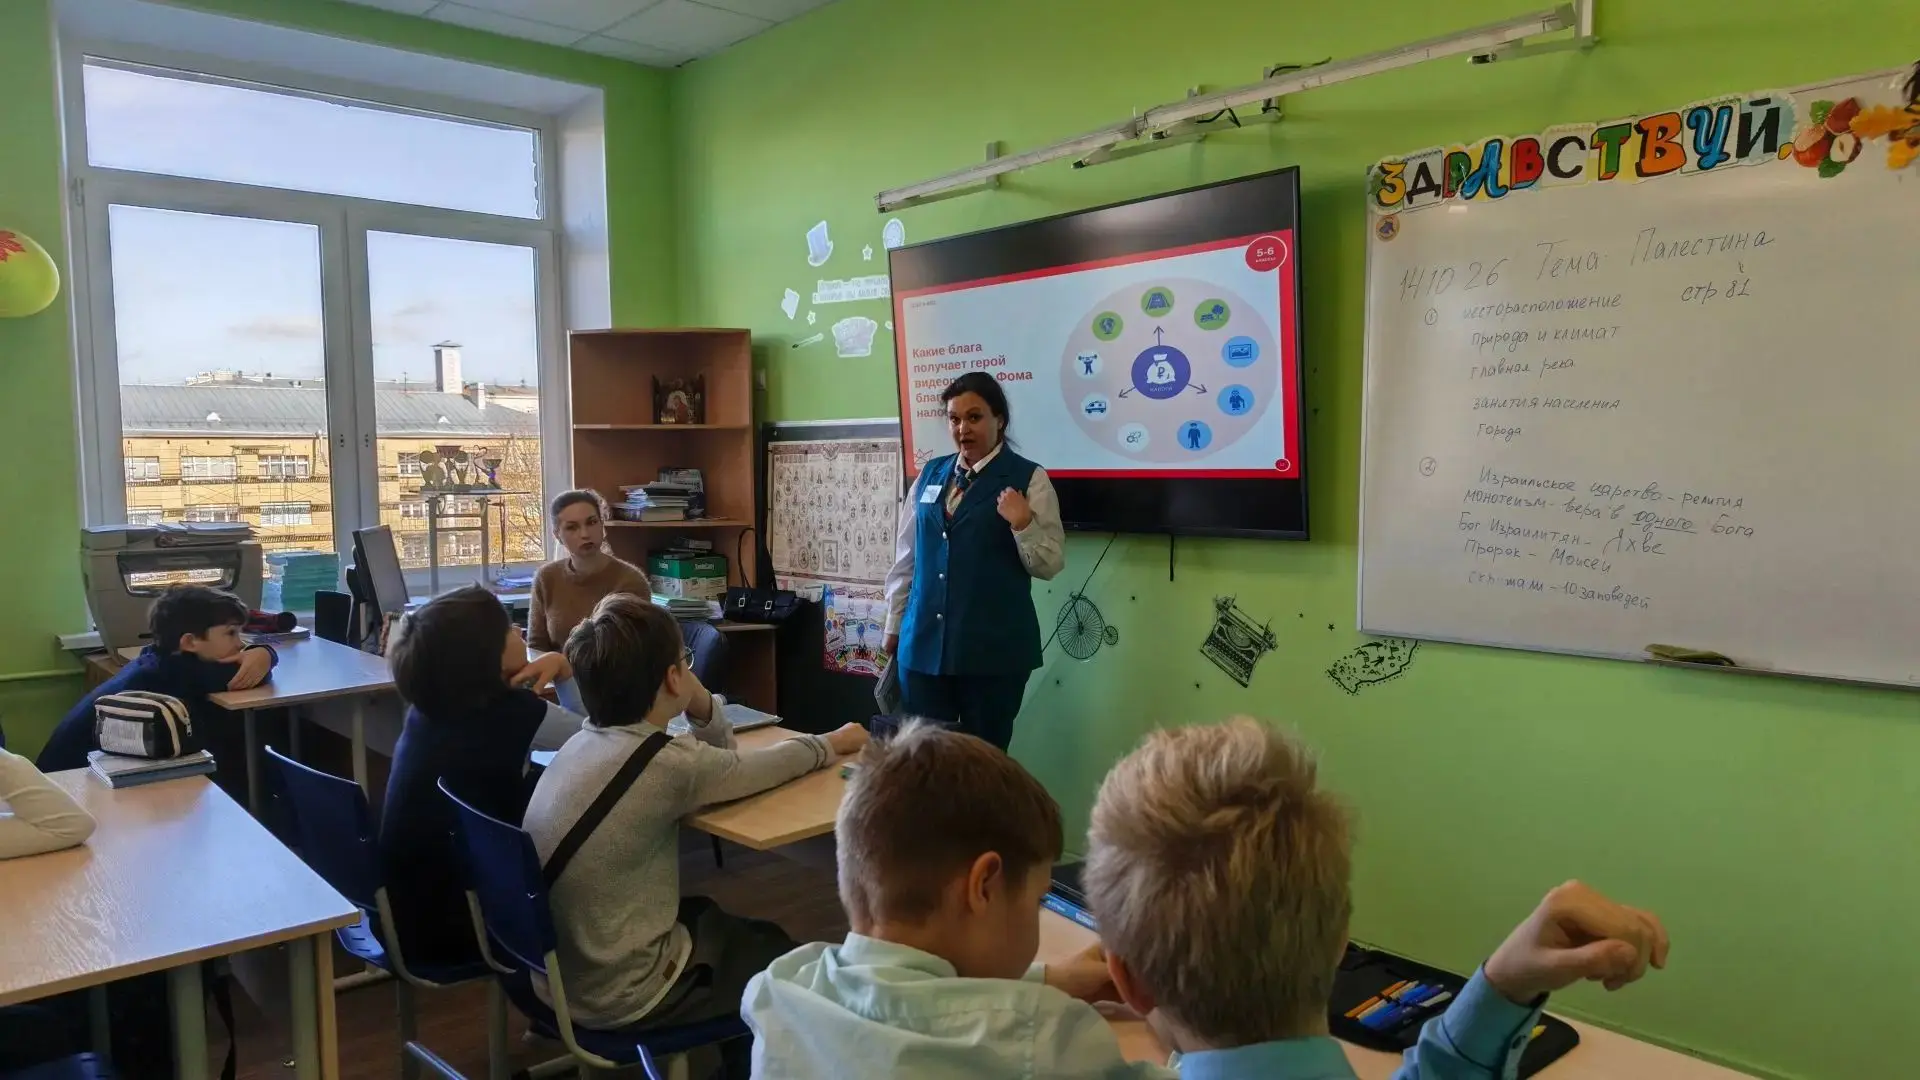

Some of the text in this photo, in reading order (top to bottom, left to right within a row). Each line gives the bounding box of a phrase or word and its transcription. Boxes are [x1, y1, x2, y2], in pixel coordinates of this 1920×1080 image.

[1256, 247, 1274, 257] 5-6
[1630, 227, 1775, 266] Палестина
[912, 343, 982, 358] Какие блага
[914, 354, 1006, 374] получает герой
[996, 371, 1033, 382] Фома
[1479, 465, 1577, 492] Израильское
[1459, 511, 1481, 531] Бог
[1711, 513, 1754, 537] Бога
[1464, 539, 1521, 563] Пророк
